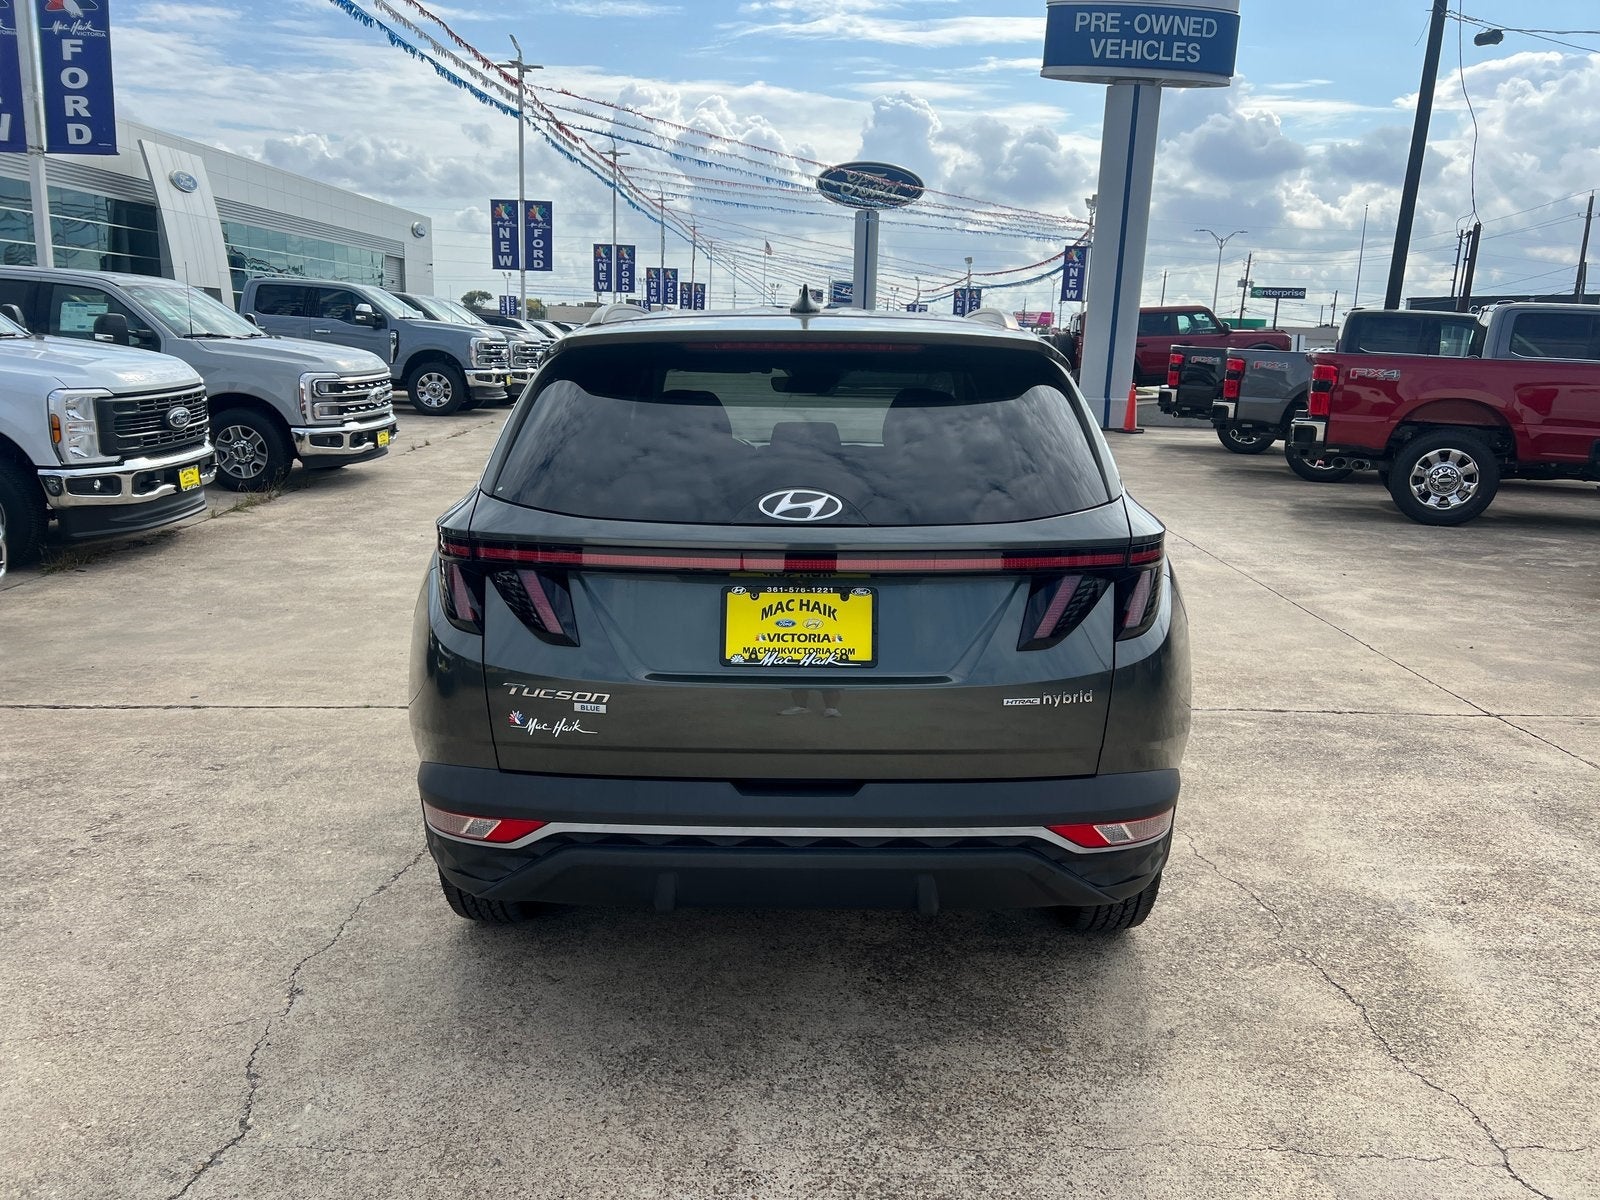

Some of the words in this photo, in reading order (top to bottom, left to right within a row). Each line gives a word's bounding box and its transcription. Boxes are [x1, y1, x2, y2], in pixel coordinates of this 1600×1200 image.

[1074, 12, 1217, 38] PRE-OWNED
[1090, 38, 1201, 63] VEHICLES
[60, 39, 93, 145] FORD
[498, 227, 513, 267] NEW
[532, 228, 544, 268] FORD
[597, 262, 608, 290] NEW
[621, 264, 630, 291] FORD
[1066, 267, 1078, 299] NEW
[650, 281, 658, 303] NEW
[1255, 289, 1305, 297] enterprise
[1350, 367, 1400, 380] FX4
[760, 599, 795, 621] MAC
[799, 599, 838, 621] HAIK
[767, 633, 832, 643] VICTORIA
[742, 647, 856, 656] MACHAIKVICTORIA.COM
[759, 651, 799, 667] Mac
[800, 651, 846, 667] Haik
[580, 704, 601, 712] BLUE
[1042, 690, 1093, 708] hybrid
[521, 717, 552, 736] Mac
[552, 717, 591, 738] Haik
